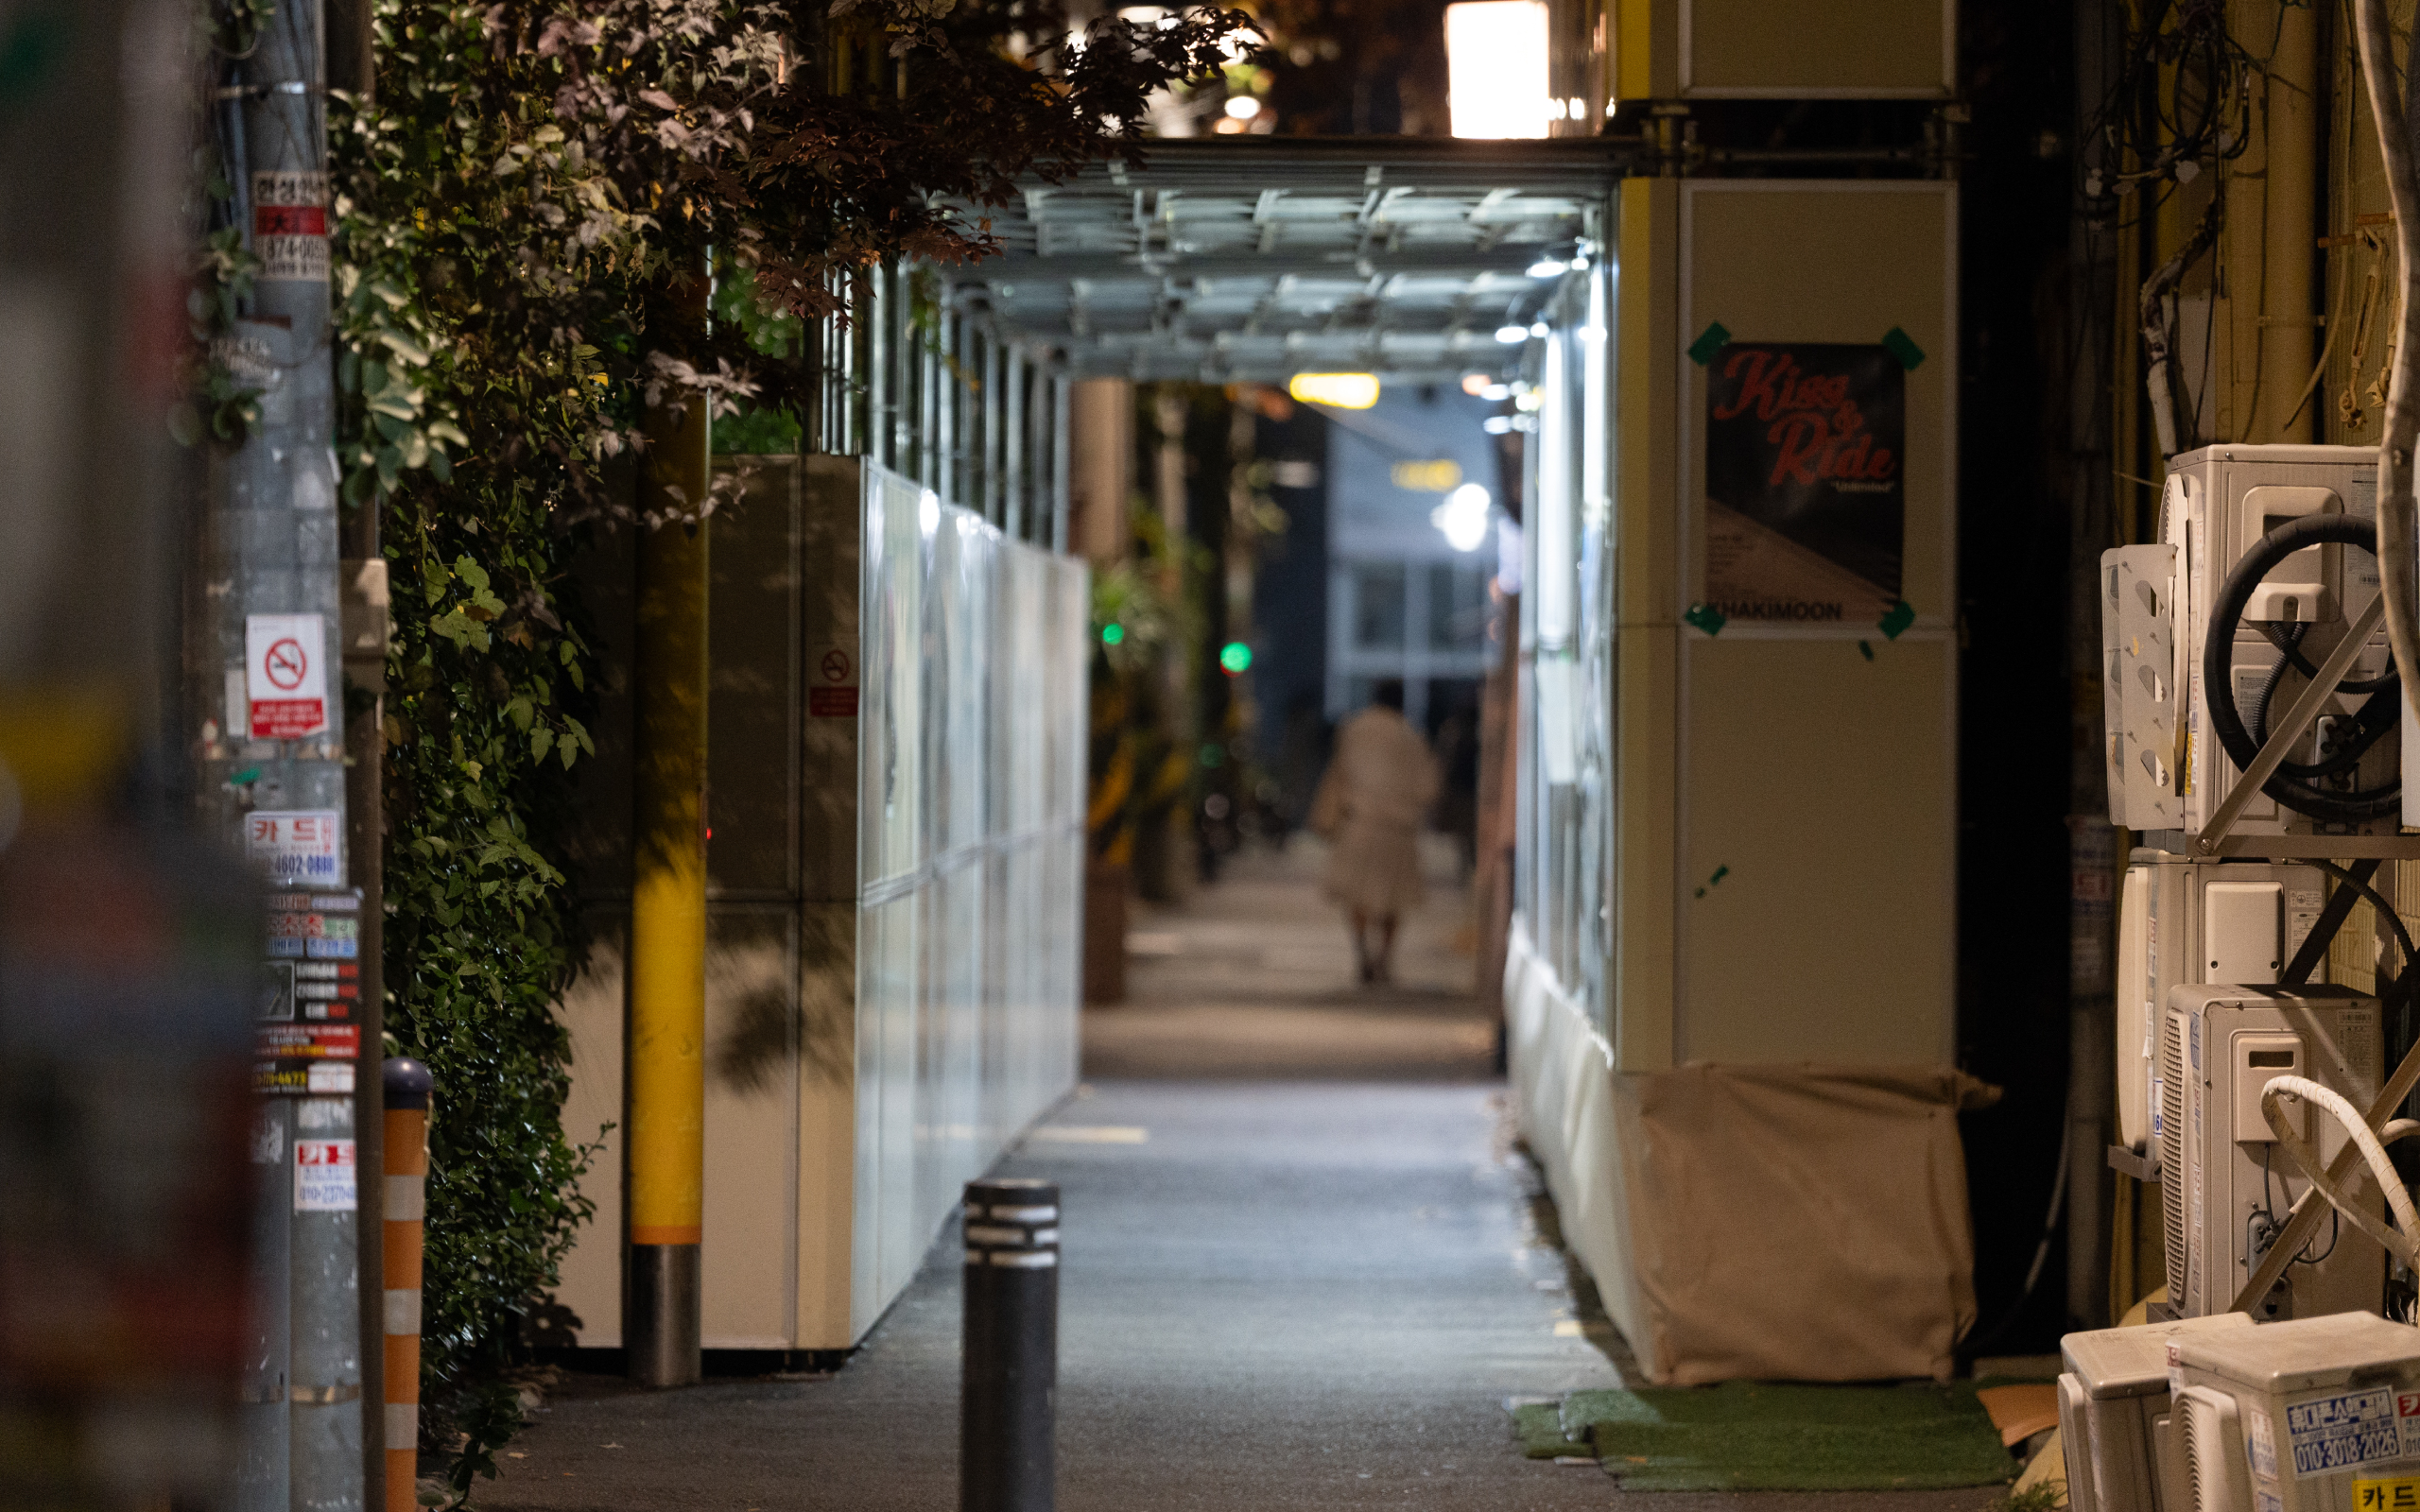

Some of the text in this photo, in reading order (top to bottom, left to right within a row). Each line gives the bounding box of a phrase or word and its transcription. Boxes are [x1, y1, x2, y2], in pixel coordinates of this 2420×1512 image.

[1713, 351, 1863, 443] Kiss &
[1768, 412, 1896, 486] Ride
[2296, 1429, 2397, 1471] 010-3018-2026
[2362, 1486, 2416, 1511] 카드
